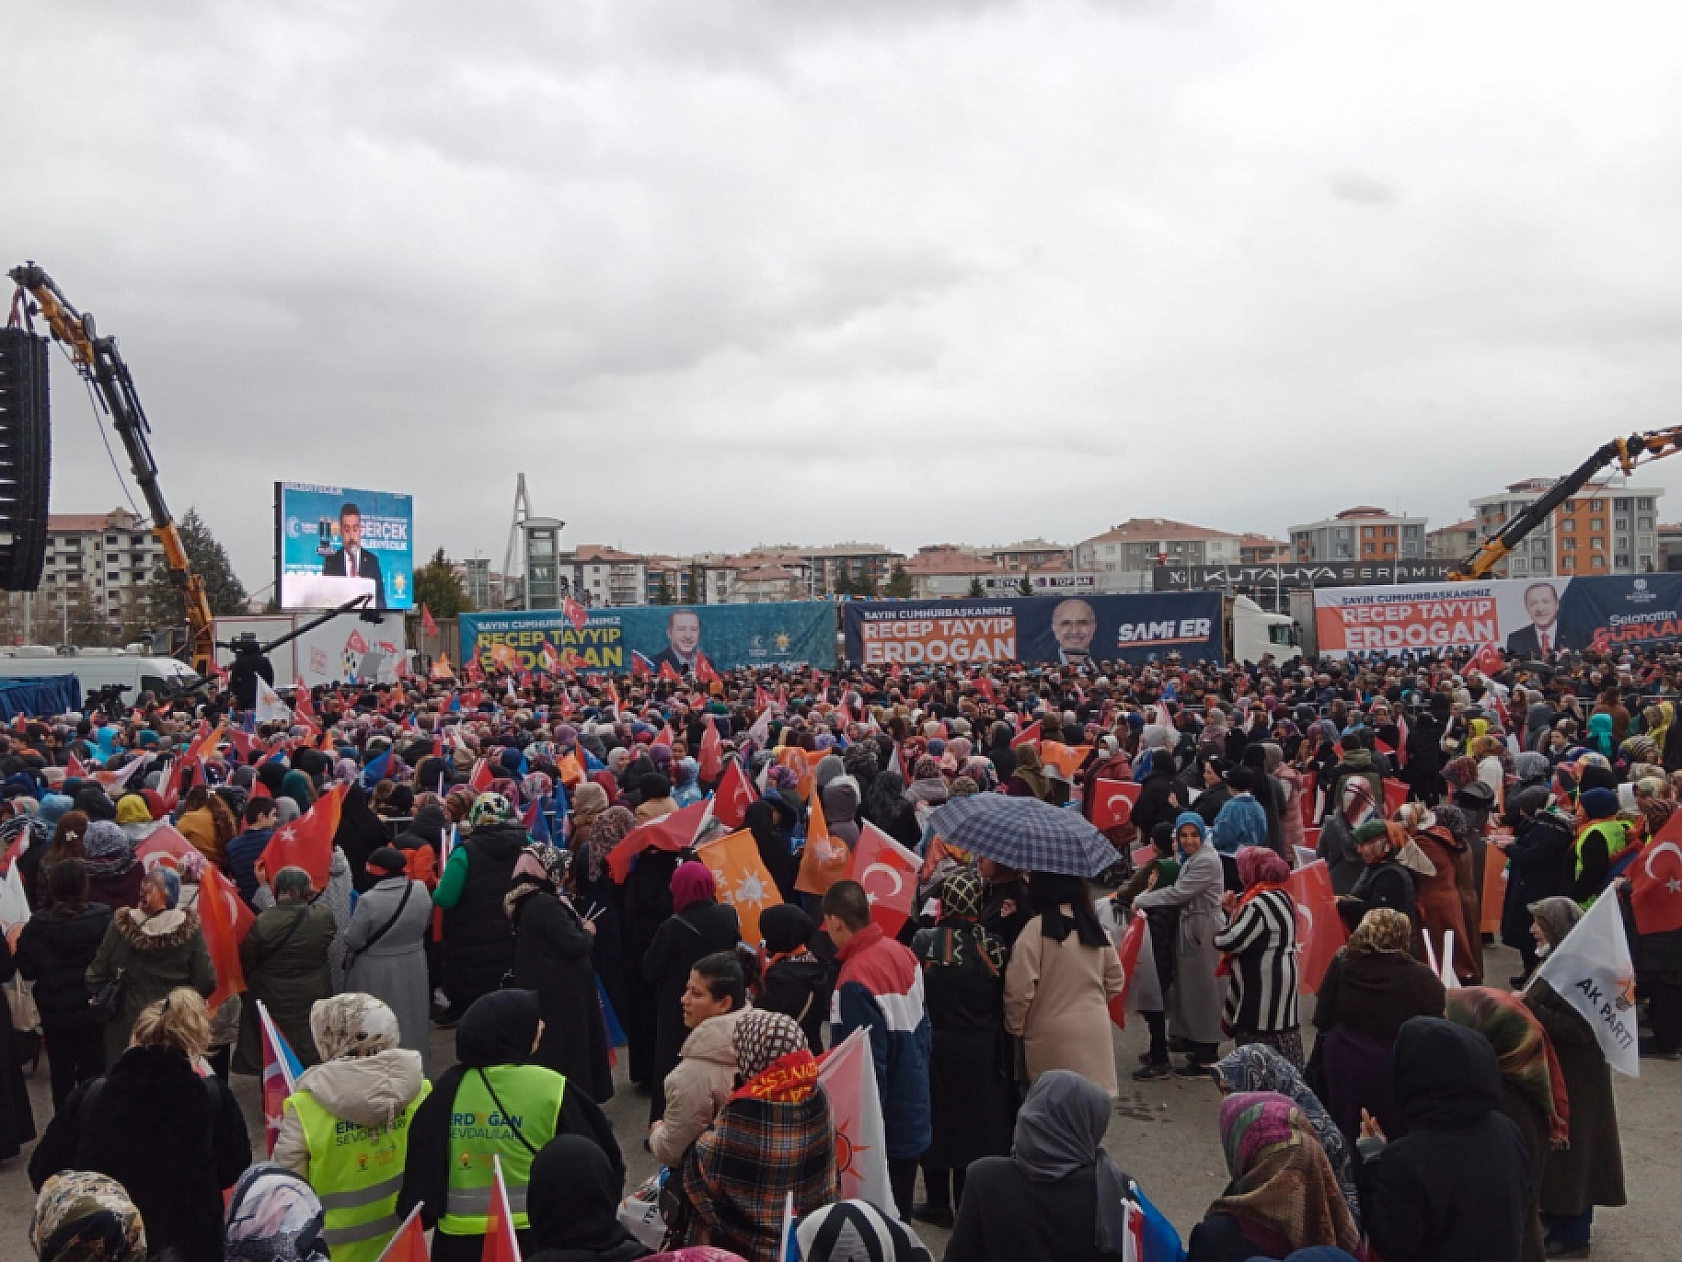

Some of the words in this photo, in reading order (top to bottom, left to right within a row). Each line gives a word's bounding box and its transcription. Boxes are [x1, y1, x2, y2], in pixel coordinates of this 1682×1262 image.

[1341, 596, 1374, 605] SAYIN
[864, 610, 897, 621] SAYIN
[900, 606, 1013, 618] CUMHURBAŞKANIMIZ
[1342, 605, 1412, 623] RECEP
[477, 621, 509, 630] SAYIN
[864, 621, 933, 639] RECEP
[1179, 618, 1211, 637] ER
[1344, 619, 1494, 648] ERDOĞAN
[478, 631, 545, 648] RECEP
[866, 637, 1015, 664] ERDOĞAN
[1575, 977, 1604, 1006] AK
